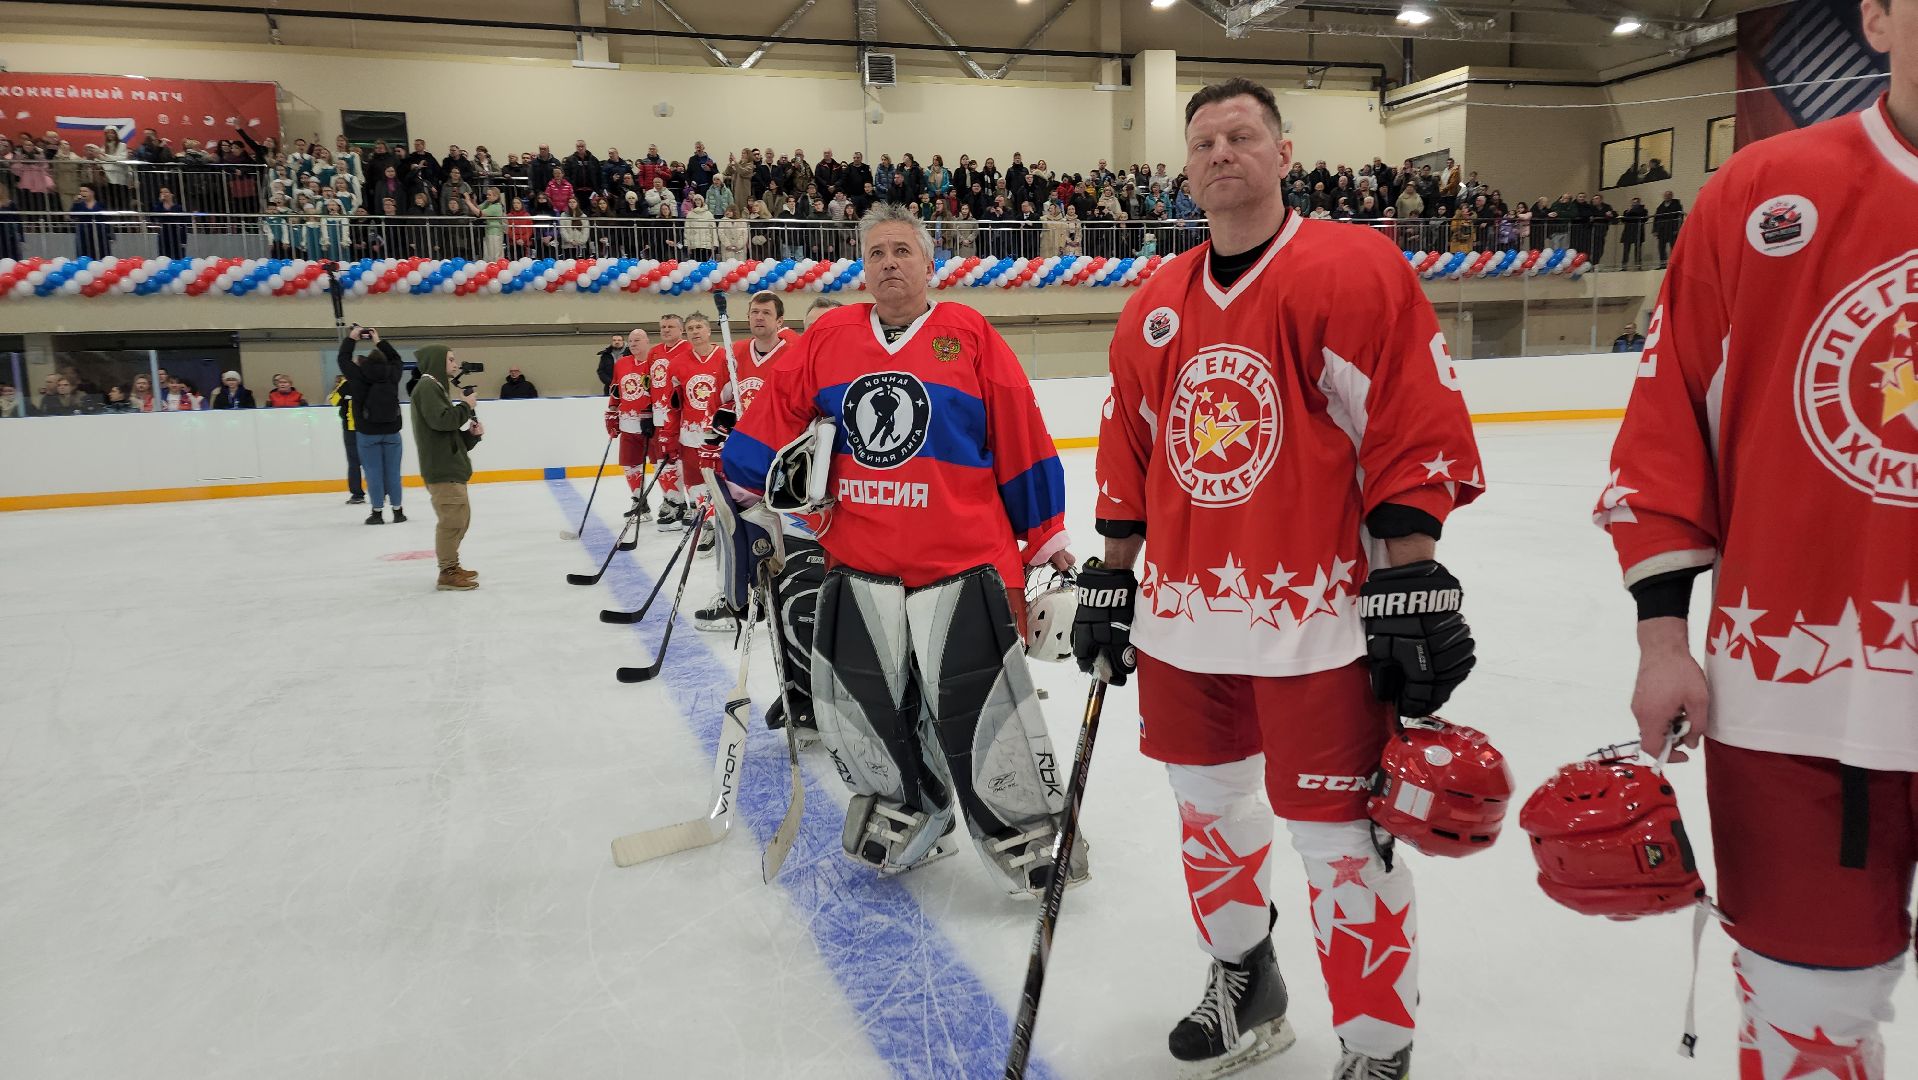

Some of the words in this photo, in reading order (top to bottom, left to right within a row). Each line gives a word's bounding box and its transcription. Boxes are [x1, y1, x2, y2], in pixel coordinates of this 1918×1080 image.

[131, 90, 183, 102] МАТЧ
[864, 376, 909, 388] НОЧНАЯ
[849, 430, 897, 463] ХОКЕЙНАЯ
[900, 429, 923, 457] ЛИГА
[838, 479, 929, 508] РОССИЯ
[716, 739, 742, 817] VAPOR
[1297, 774, 1379, 792] CCM
